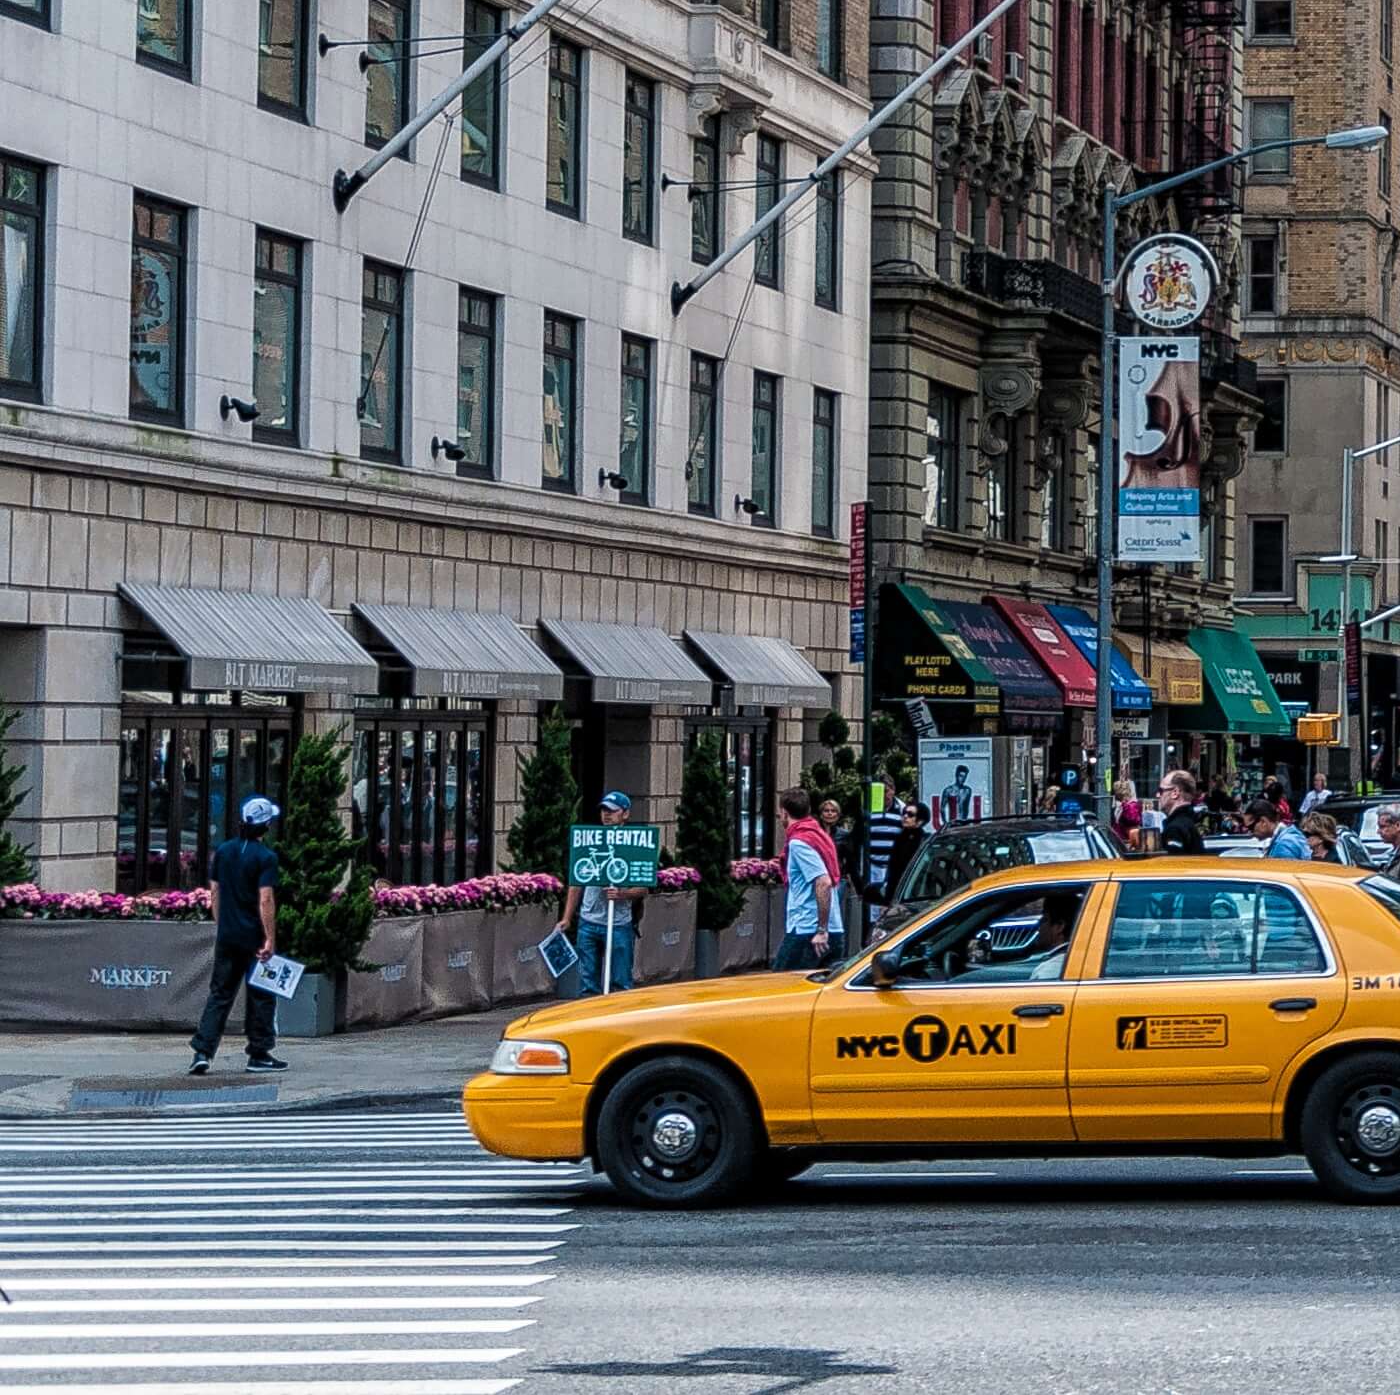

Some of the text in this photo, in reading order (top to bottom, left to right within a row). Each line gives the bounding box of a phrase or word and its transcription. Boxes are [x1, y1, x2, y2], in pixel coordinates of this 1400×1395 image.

[1143, 313, 1195, 326] BARBADOS
[1141, 344, 1179, 358] NYC
[1158, 492, 1175, 501] Arts
[904, 655, 951, 666] PLAY LOTTO
[225, 661, 245, 685] BLT
[248, 663, 297, 688] MARKET
[915, 667, 940, 678] HERE
[1267, 672, 1303, 685] PARK
[907, 684, 967, 696] PHONE CARDS
[938, 743, 972, 752] Phone
[573, 829, 656, 849] BIKE RENTAL
[89, 967, 172, 985] MARKET
[836, 1020, 1017, 1058] NYC TAXI
